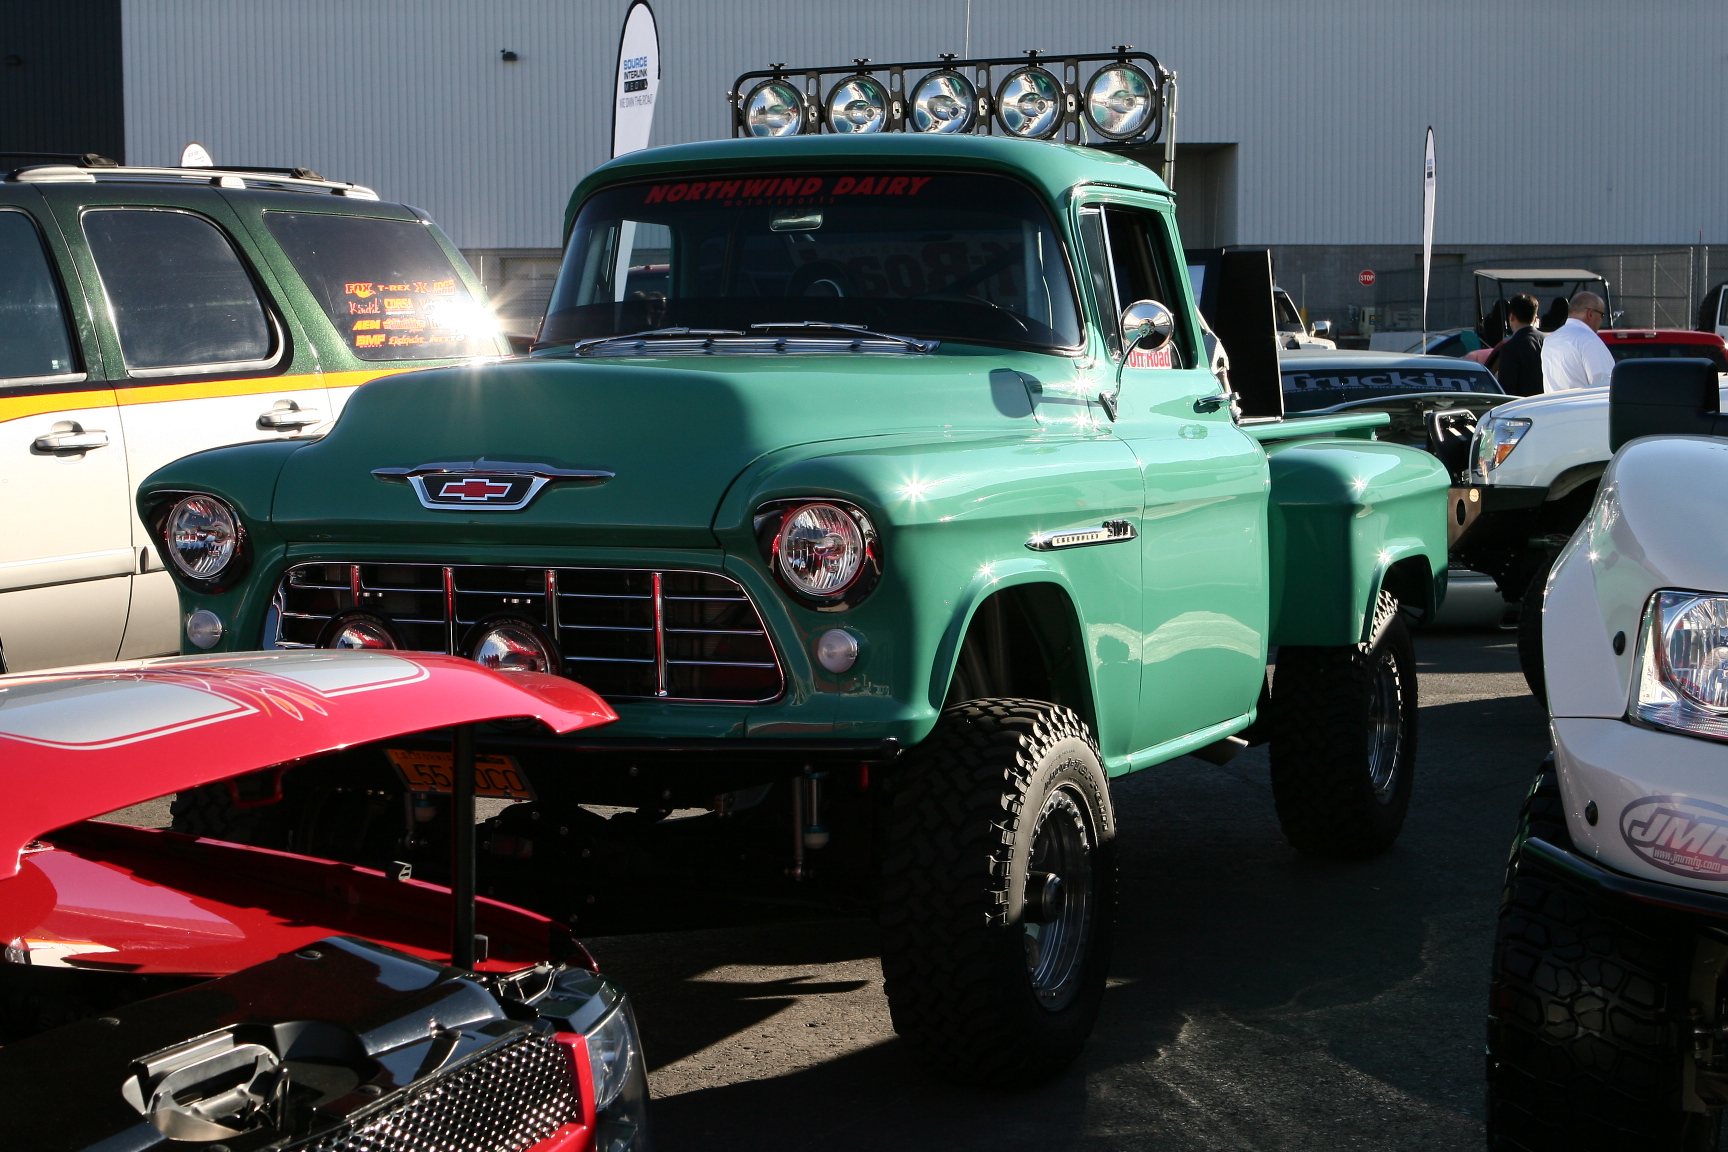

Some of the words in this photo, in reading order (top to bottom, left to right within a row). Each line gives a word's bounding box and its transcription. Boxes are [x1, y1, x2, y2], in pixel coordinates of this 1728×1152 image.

[623, 56, 647, 70] SOURCE
[624, 68, 647, 80] INTERLINK
[644, 177, 823, 204] NORTHWIND
[831, 176, 932, 195] DAIRY
[723, 196, 835, 207] motorsports
[1360, 274, 1375, 282] STOP
[345, 283, 374, 295] FOX
[378, 284, 411, 292] T-REX
[384, 298, 413, 310] CORSA
[352, 320, 381, 330] AEM
[1282, 371, 1477, 392] Truckin'
[1056, 533, 1100, 544] CHEVROLET
[396, 751, 453, 761] CALIFORNIA
[1653, 847, 1721, 873] www.jmrmfg.com
